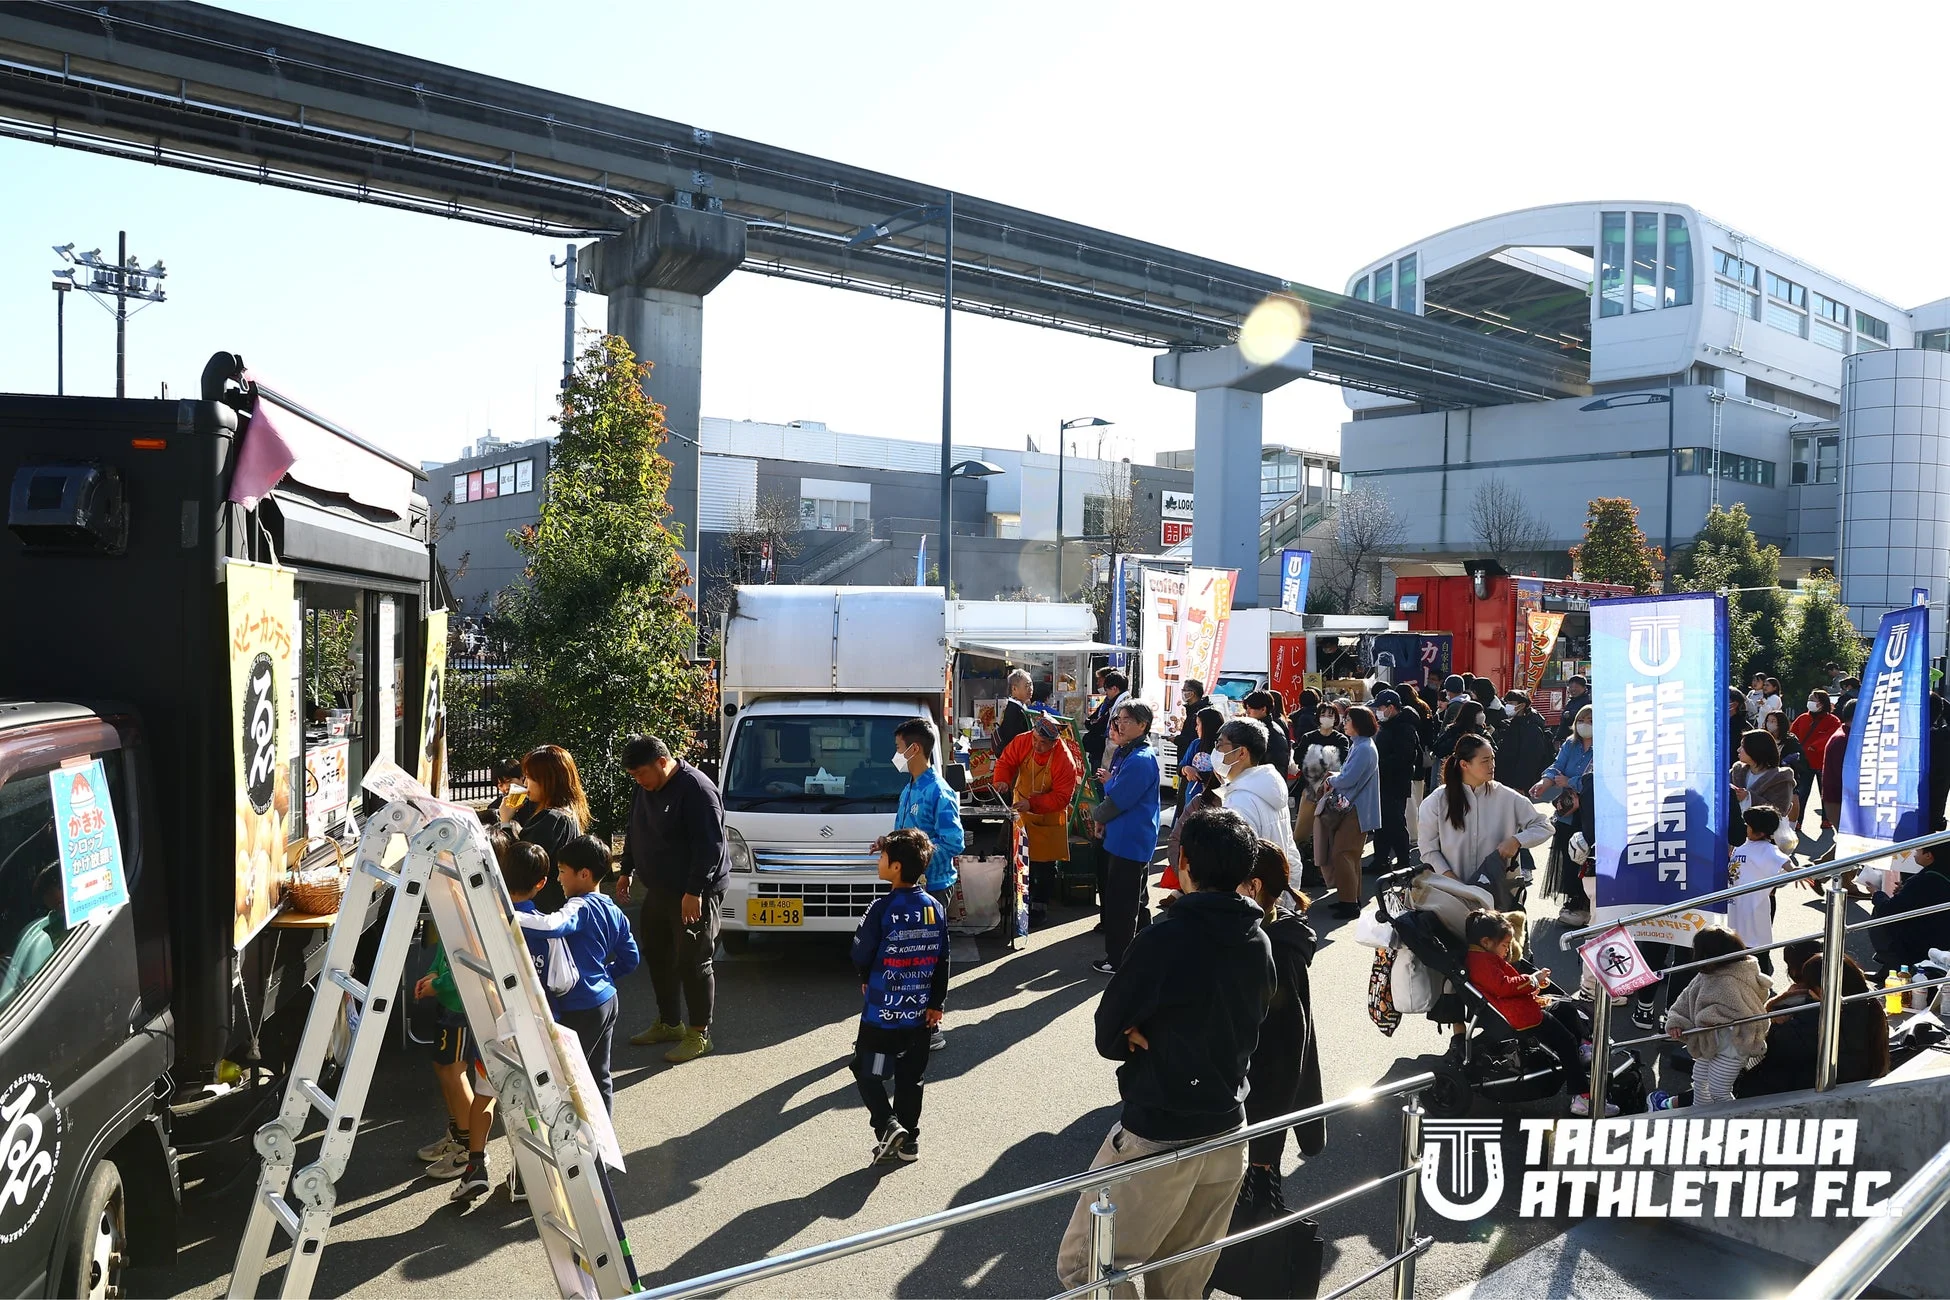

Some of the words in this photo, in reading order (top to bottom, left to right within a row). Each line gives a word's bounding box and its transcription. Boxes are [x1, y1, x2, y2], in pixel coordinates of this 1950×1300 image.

[1167, 525, 1179, 533] ユニ
[1167, 534, 1179, 542] クロ
[1150, 578, 1185, 596] coffee
[1157, 597, 1180, 712] コーヒー
[1527, 616, 1551, 697] フランク
[1421, 641, 1439, 688] カー
[69, 808, 106, 837] かき氷
[69, 832, 105, 859] シロップ
[777, 900, 791, 908] 480
[759, 909, 799, 924] 41-98
[898, 944, 926, 953] KOIZUMI
